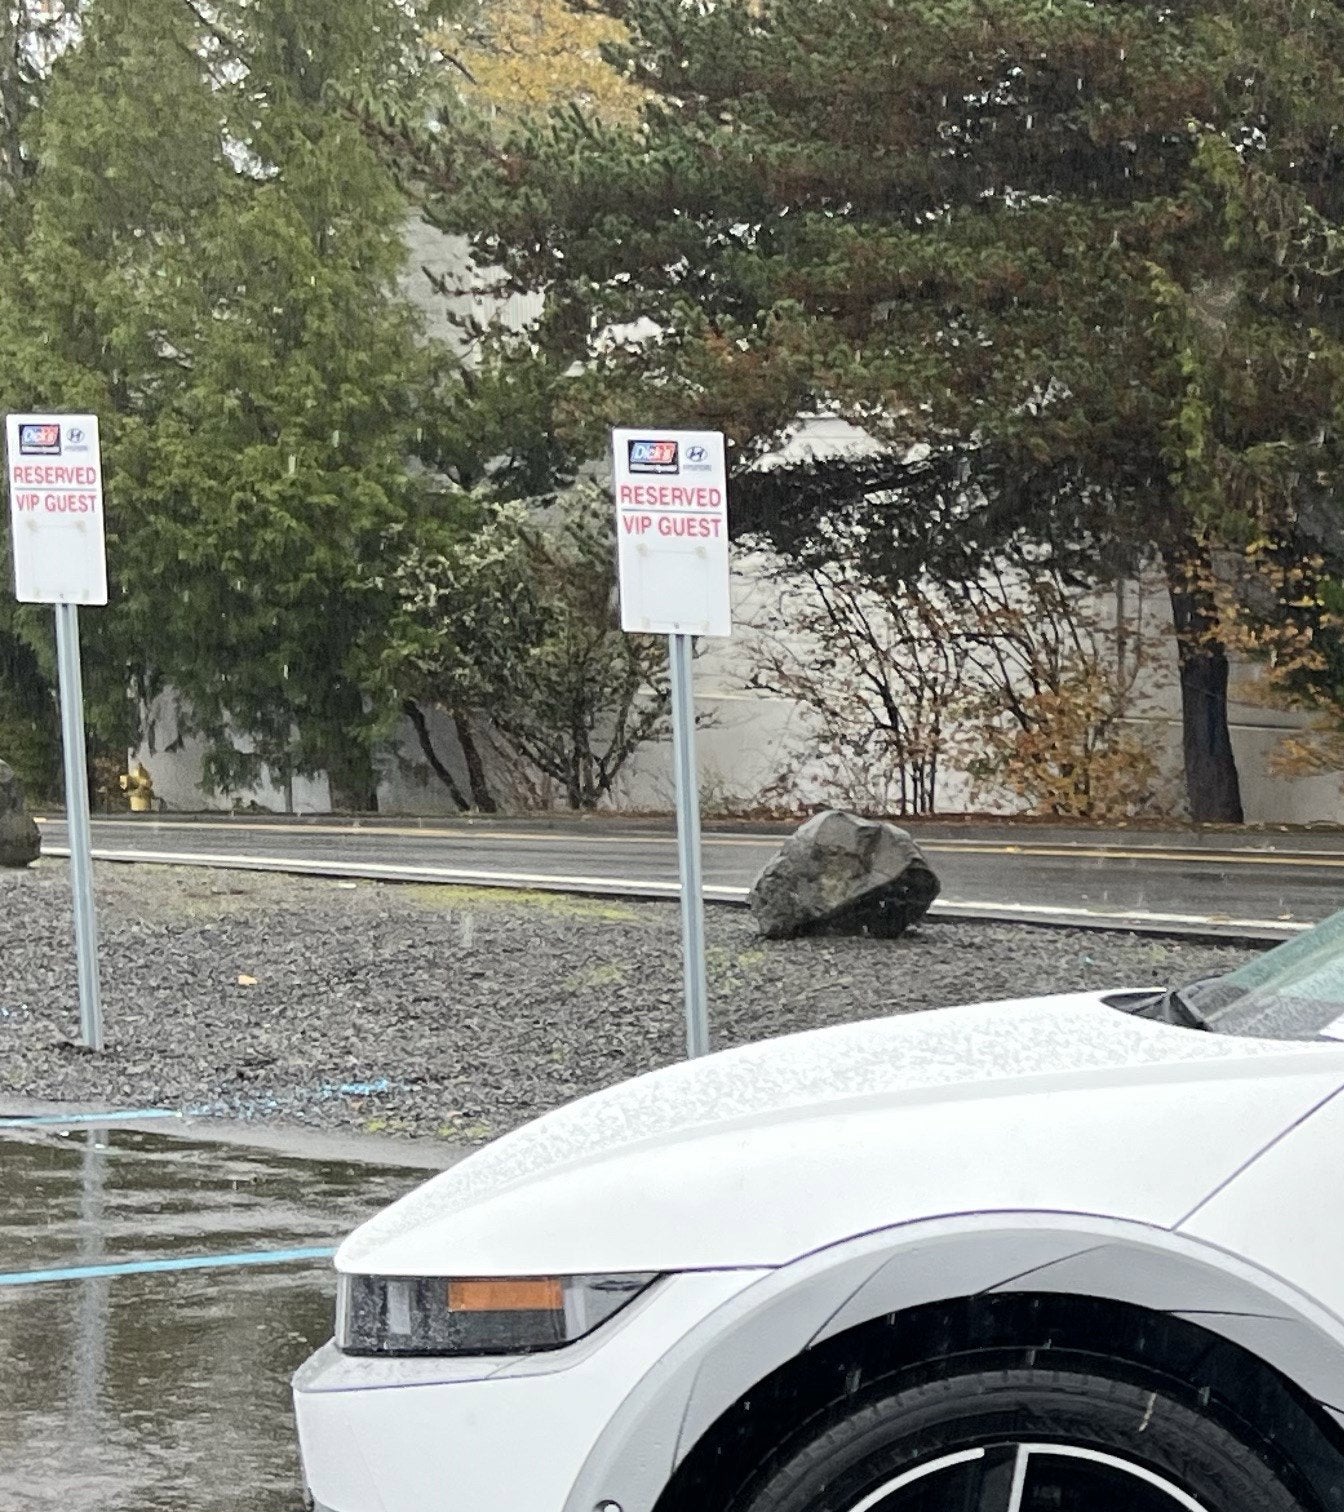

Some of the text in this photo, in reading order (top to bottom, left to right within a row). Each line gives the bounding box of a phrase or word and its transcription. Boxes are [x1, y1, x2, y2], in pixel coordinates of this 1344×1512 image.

[14, 466, 97, 485] RESERVED
[16, 494, 97, 513] VIP GUEST
[620, 484, 722, 507] RESERVED
[622, 515, 722, 538] VIP GUEST
